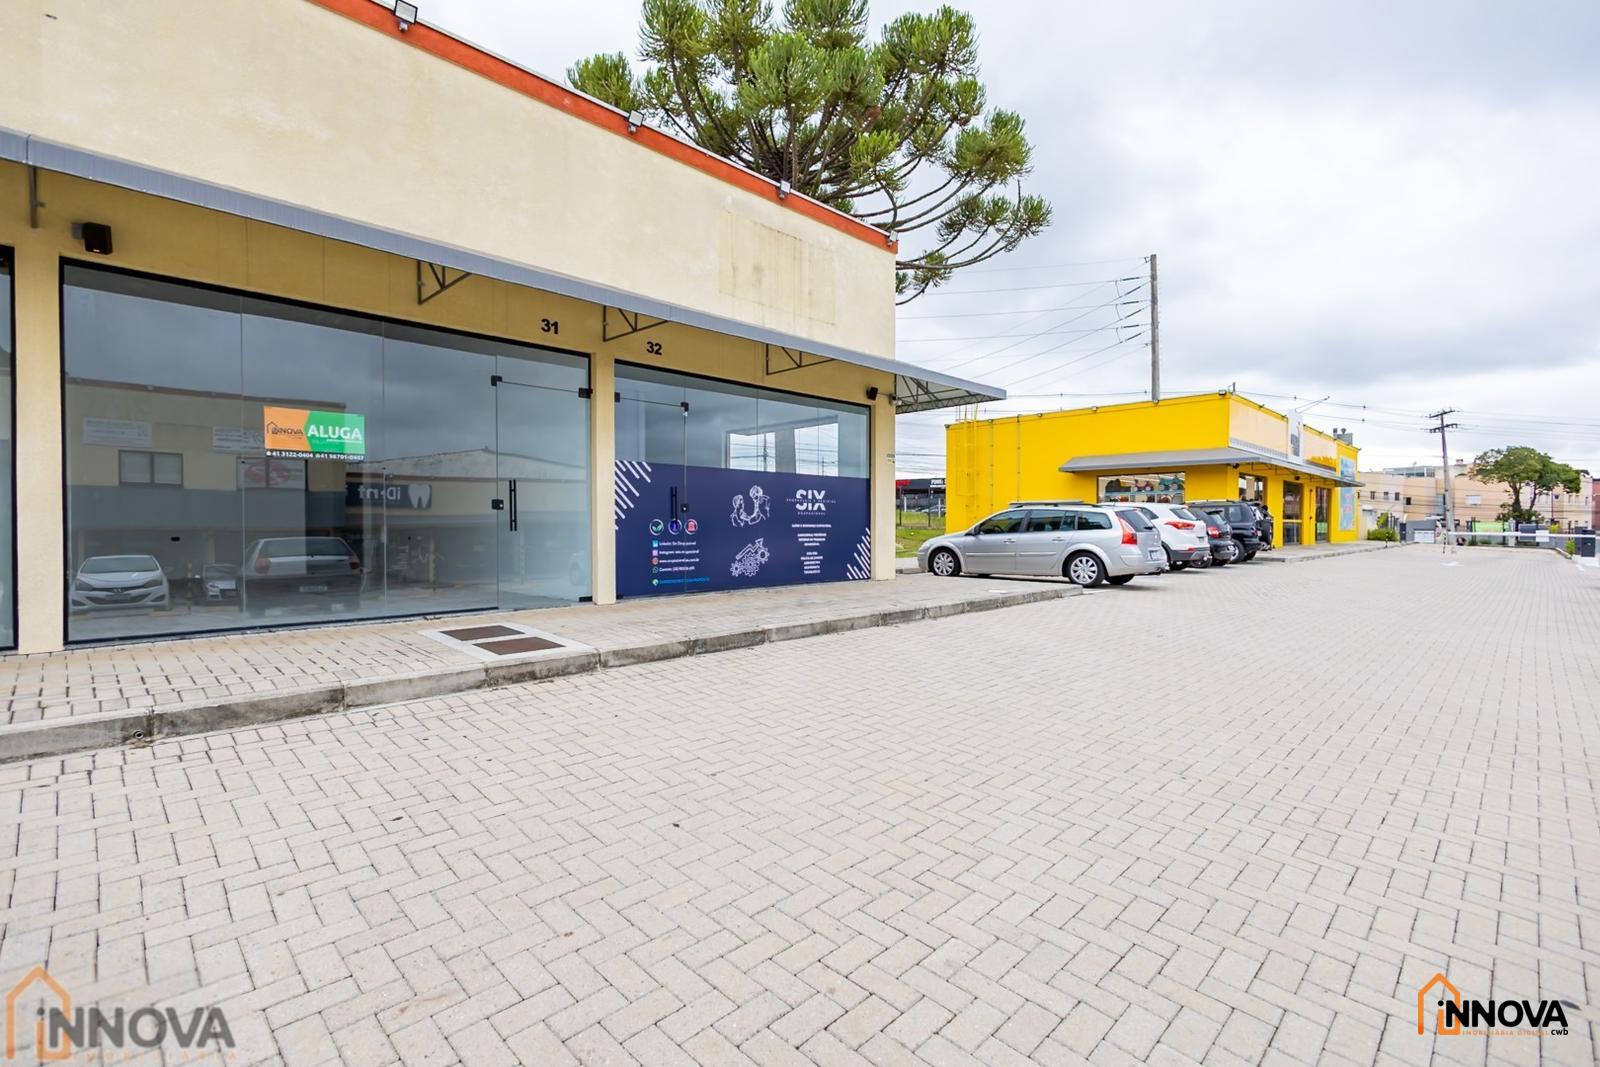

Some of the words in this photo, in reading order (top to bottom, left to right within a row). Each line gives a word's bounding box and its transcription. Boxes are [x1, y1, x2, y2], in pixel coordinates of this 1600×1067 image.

[541, 318, 559, 335] 31
[646, 341, 663, 356] 32
[307, 424, 362, 441] ALUGA
[795, 489, 826, 511] SIX
